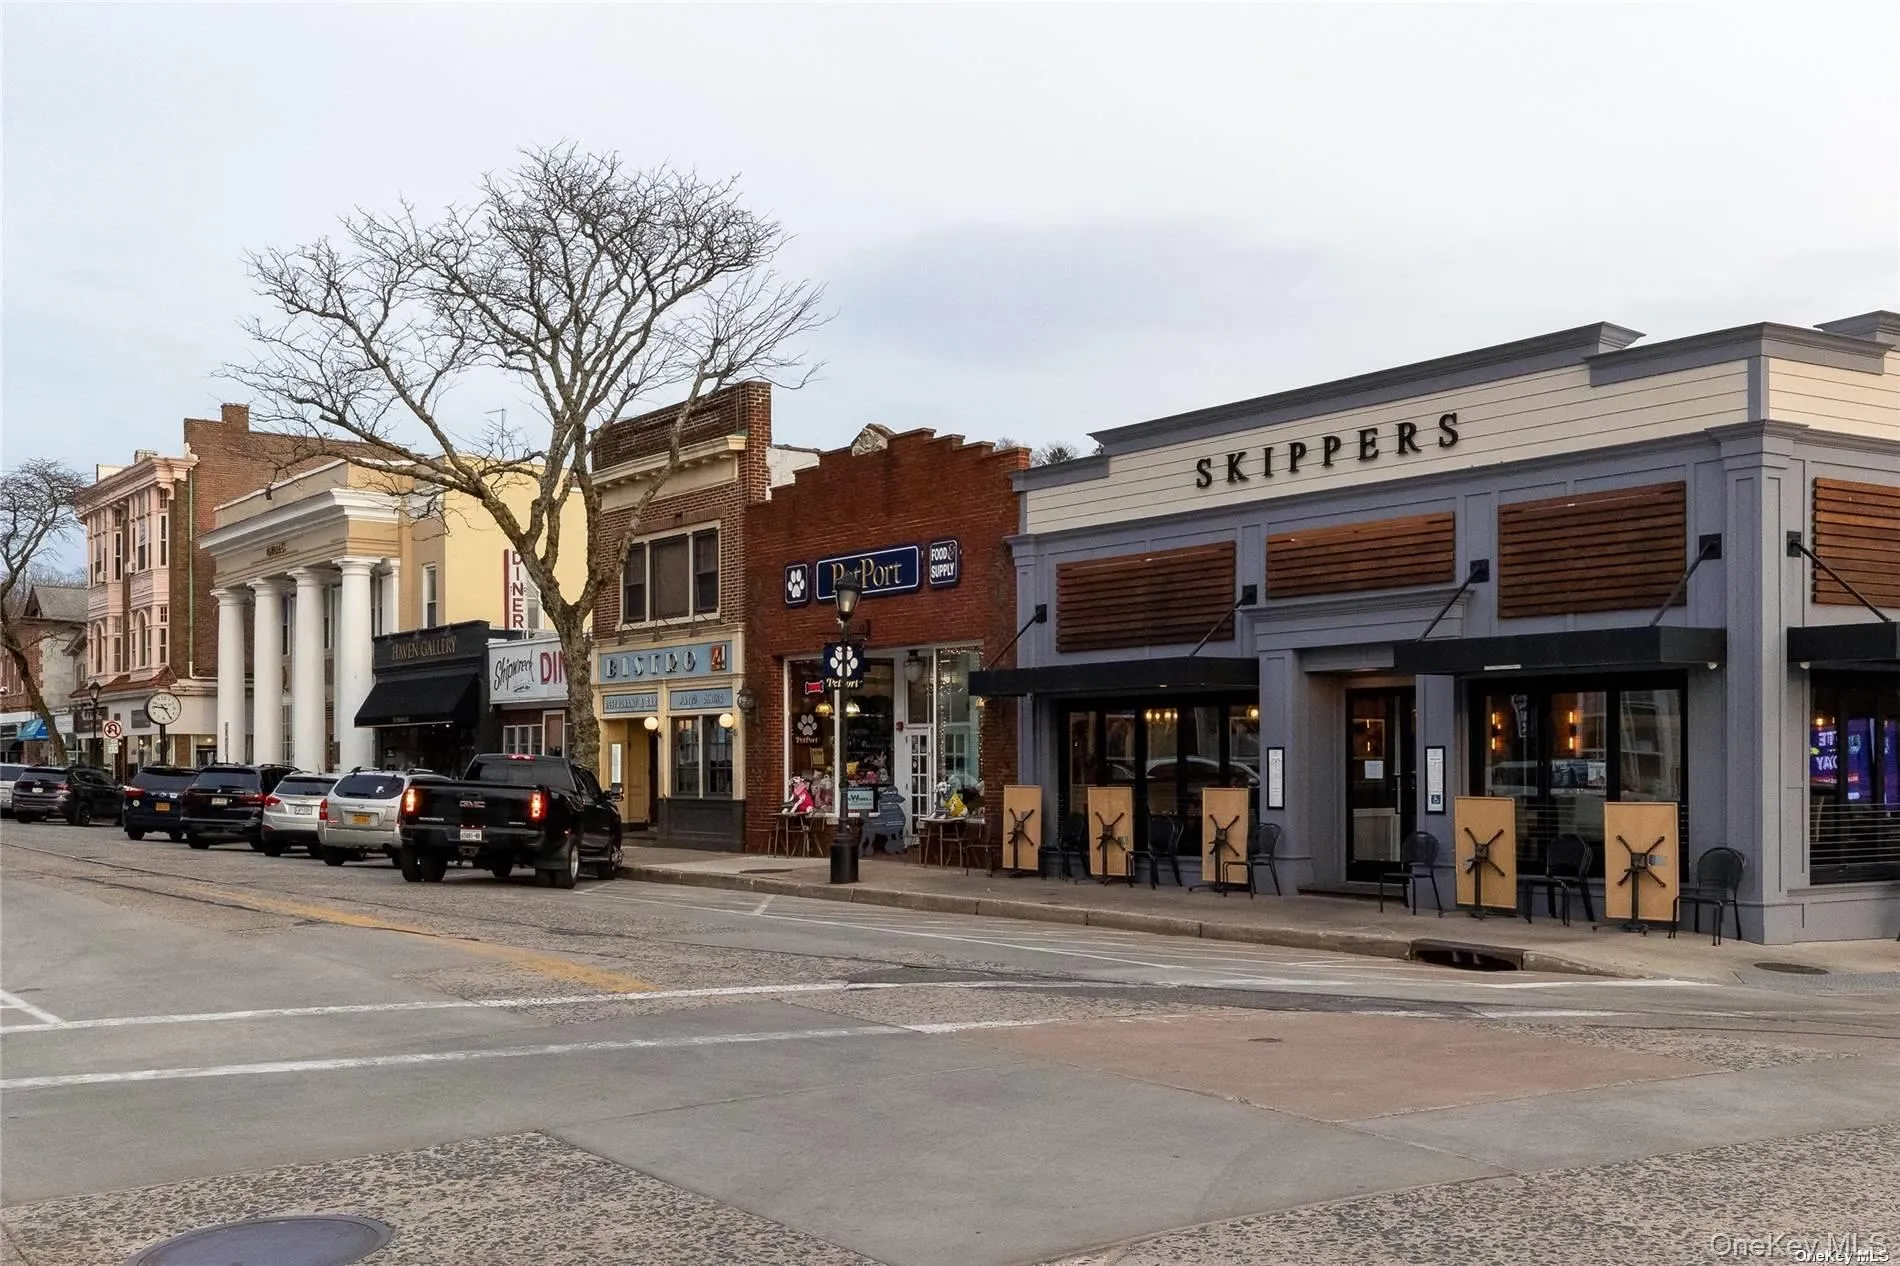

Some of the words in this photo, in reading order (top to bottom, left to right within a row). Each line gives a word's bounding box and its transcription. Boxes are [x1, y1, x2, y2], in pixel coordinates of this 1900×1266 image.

[1196, 412, 1459, 488] SKIPPERS
[931, 546, 948, 562] FOOD
[948, 543, 956, 561] &
[930, 562, 955, 579] SUPPLY
[512, 550, 524, 629] DINER
[391, 641, 419, 660] HAVEN
[419, 636, 457, 657] GALLERY
[606, 650, 697, 679] BISTRO
[711, 645, 726, 671] 4
[493, 648, 535, 691] Shipwreck
[826, 678, 859, 688] Petort
